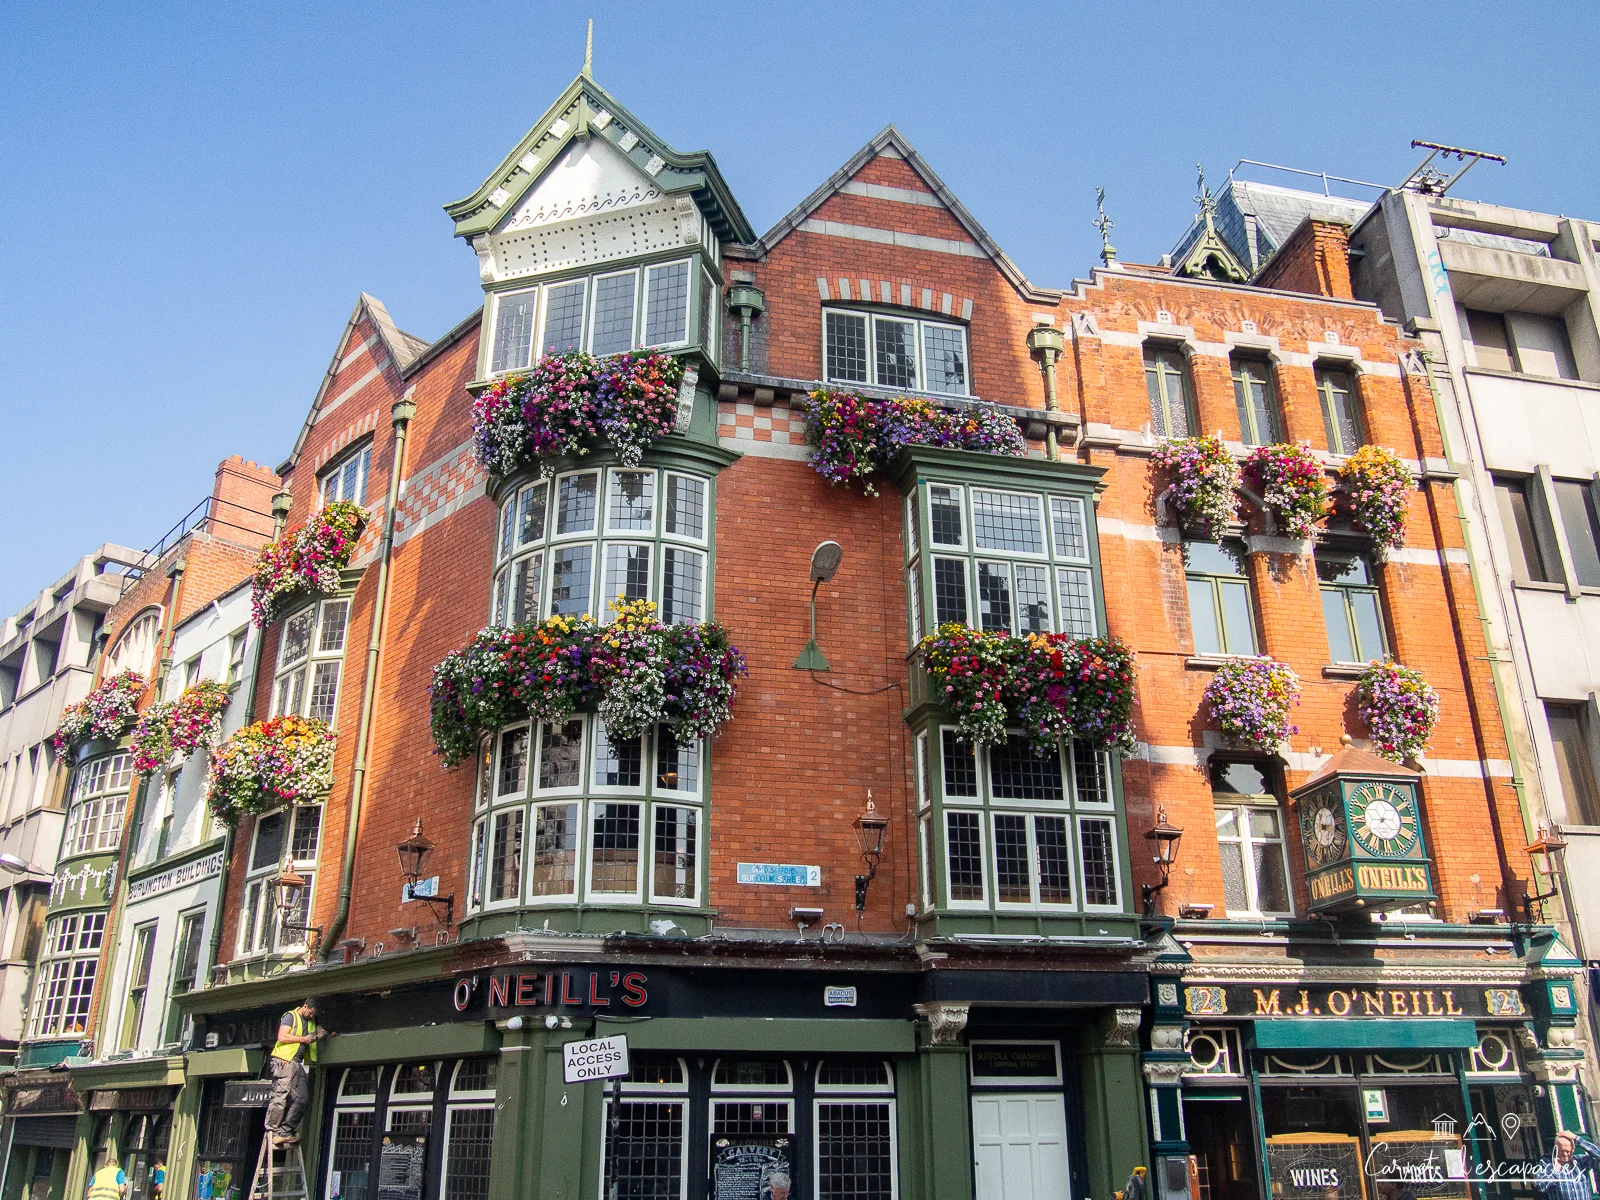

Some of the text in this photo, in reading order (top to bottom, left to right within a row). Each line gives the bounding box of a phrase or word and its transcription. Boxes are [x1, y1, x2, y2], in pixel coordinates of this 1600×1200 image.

[129, 854, 224, 899] BURLINGTON BUILDINGS
[810, 870, 818, 881] 2
[1311, 867, 1355, 900] O'NEILL'S
[1358, 865, 1428, 891] O'NEILL'S
[1198, 988, 1215, 1014] 2
[1496, 990, 1513, 1015] 2
[567, 1051, 622, 1068] ACCESS
[571, 1041, 616, 1056] LOCAL
[577, 1065, 613, 1079] ONLY
[1290, 1168, 1339, 1187] WINES
